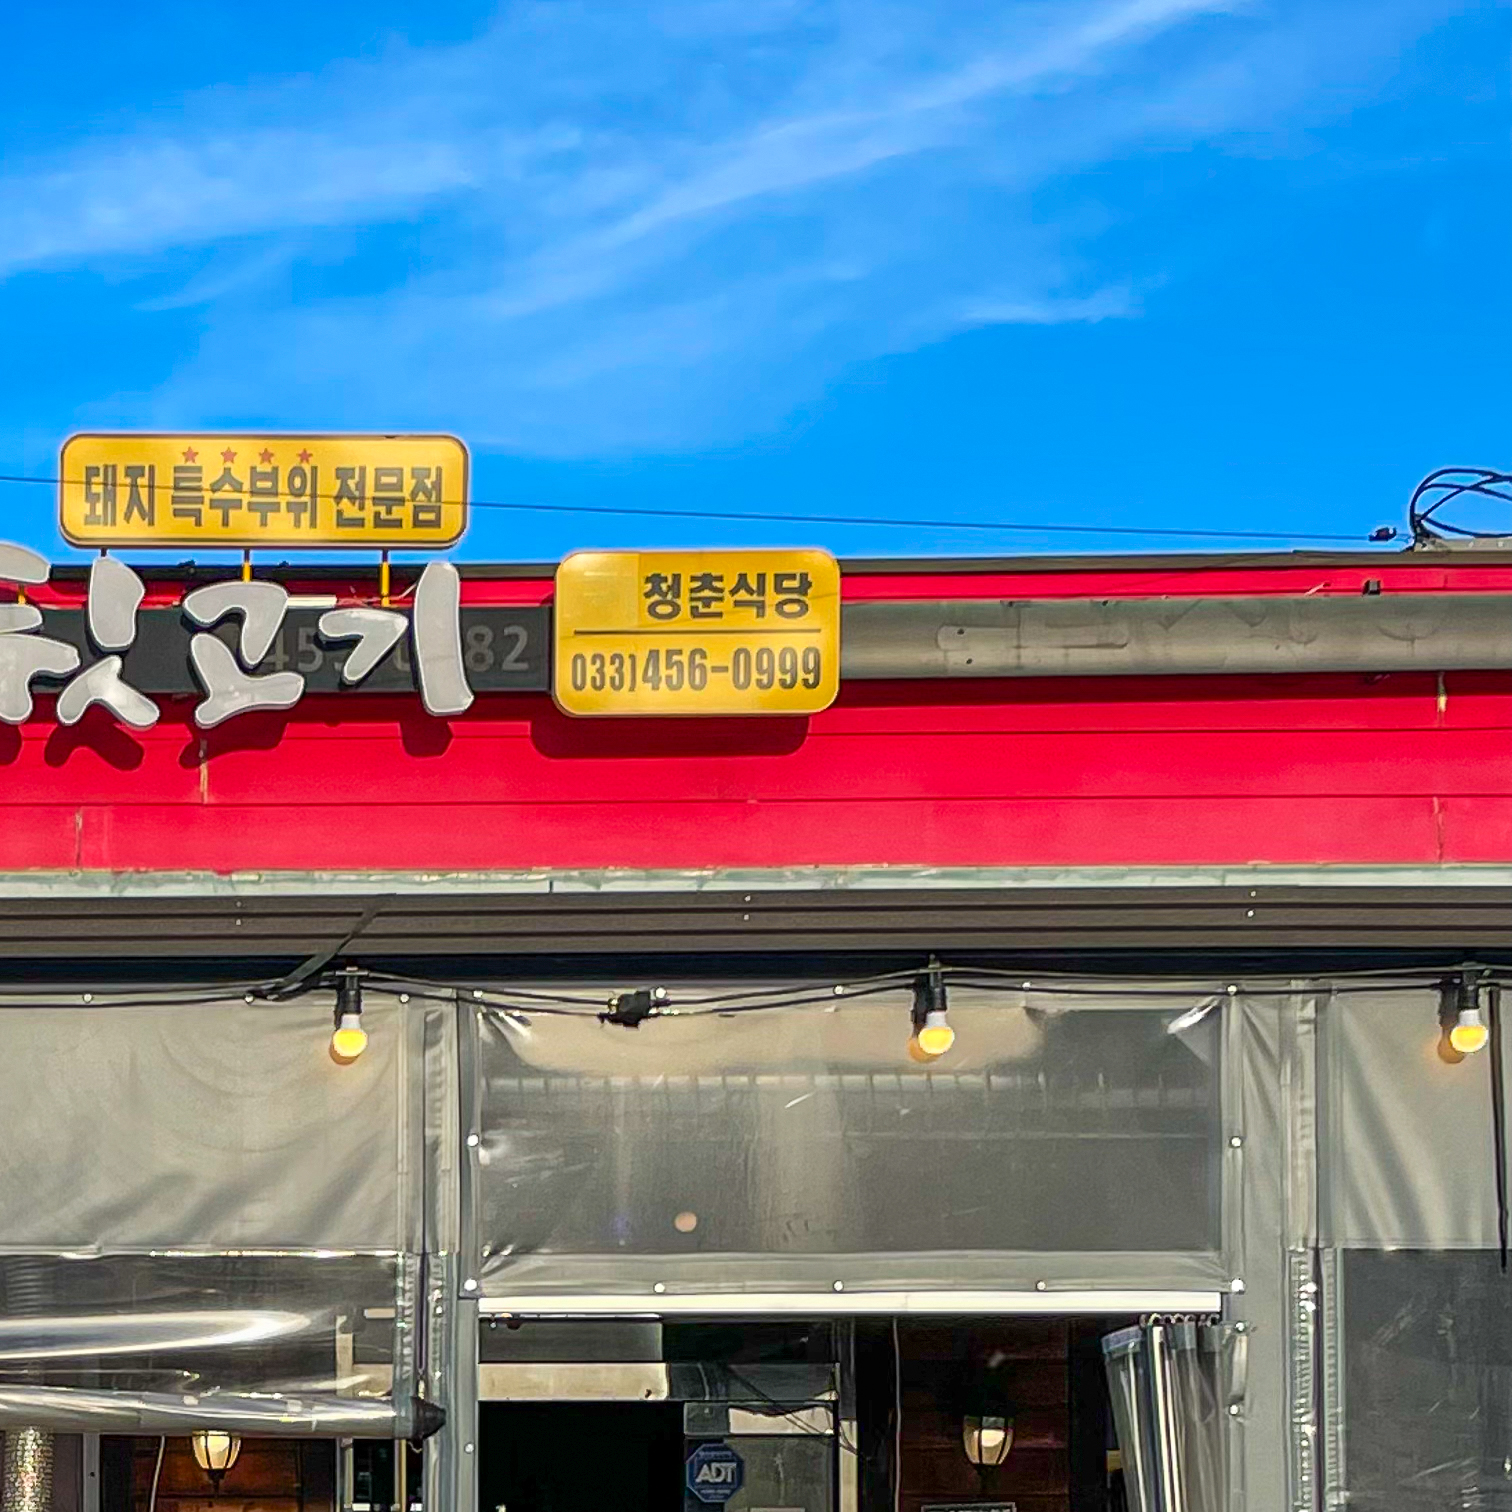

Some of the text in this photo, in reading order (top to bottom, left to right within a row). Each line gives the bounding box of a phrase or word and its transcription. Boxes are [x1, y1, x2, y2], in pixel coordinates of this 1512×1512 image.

[83, 463, 443, 529] 돼지 특수부위 전문점
[643, 571, 813, 620] 청춘식당
[571, 647, 821, 692] 033)456-0999
[695, 1462, 737, 1483] ADT
